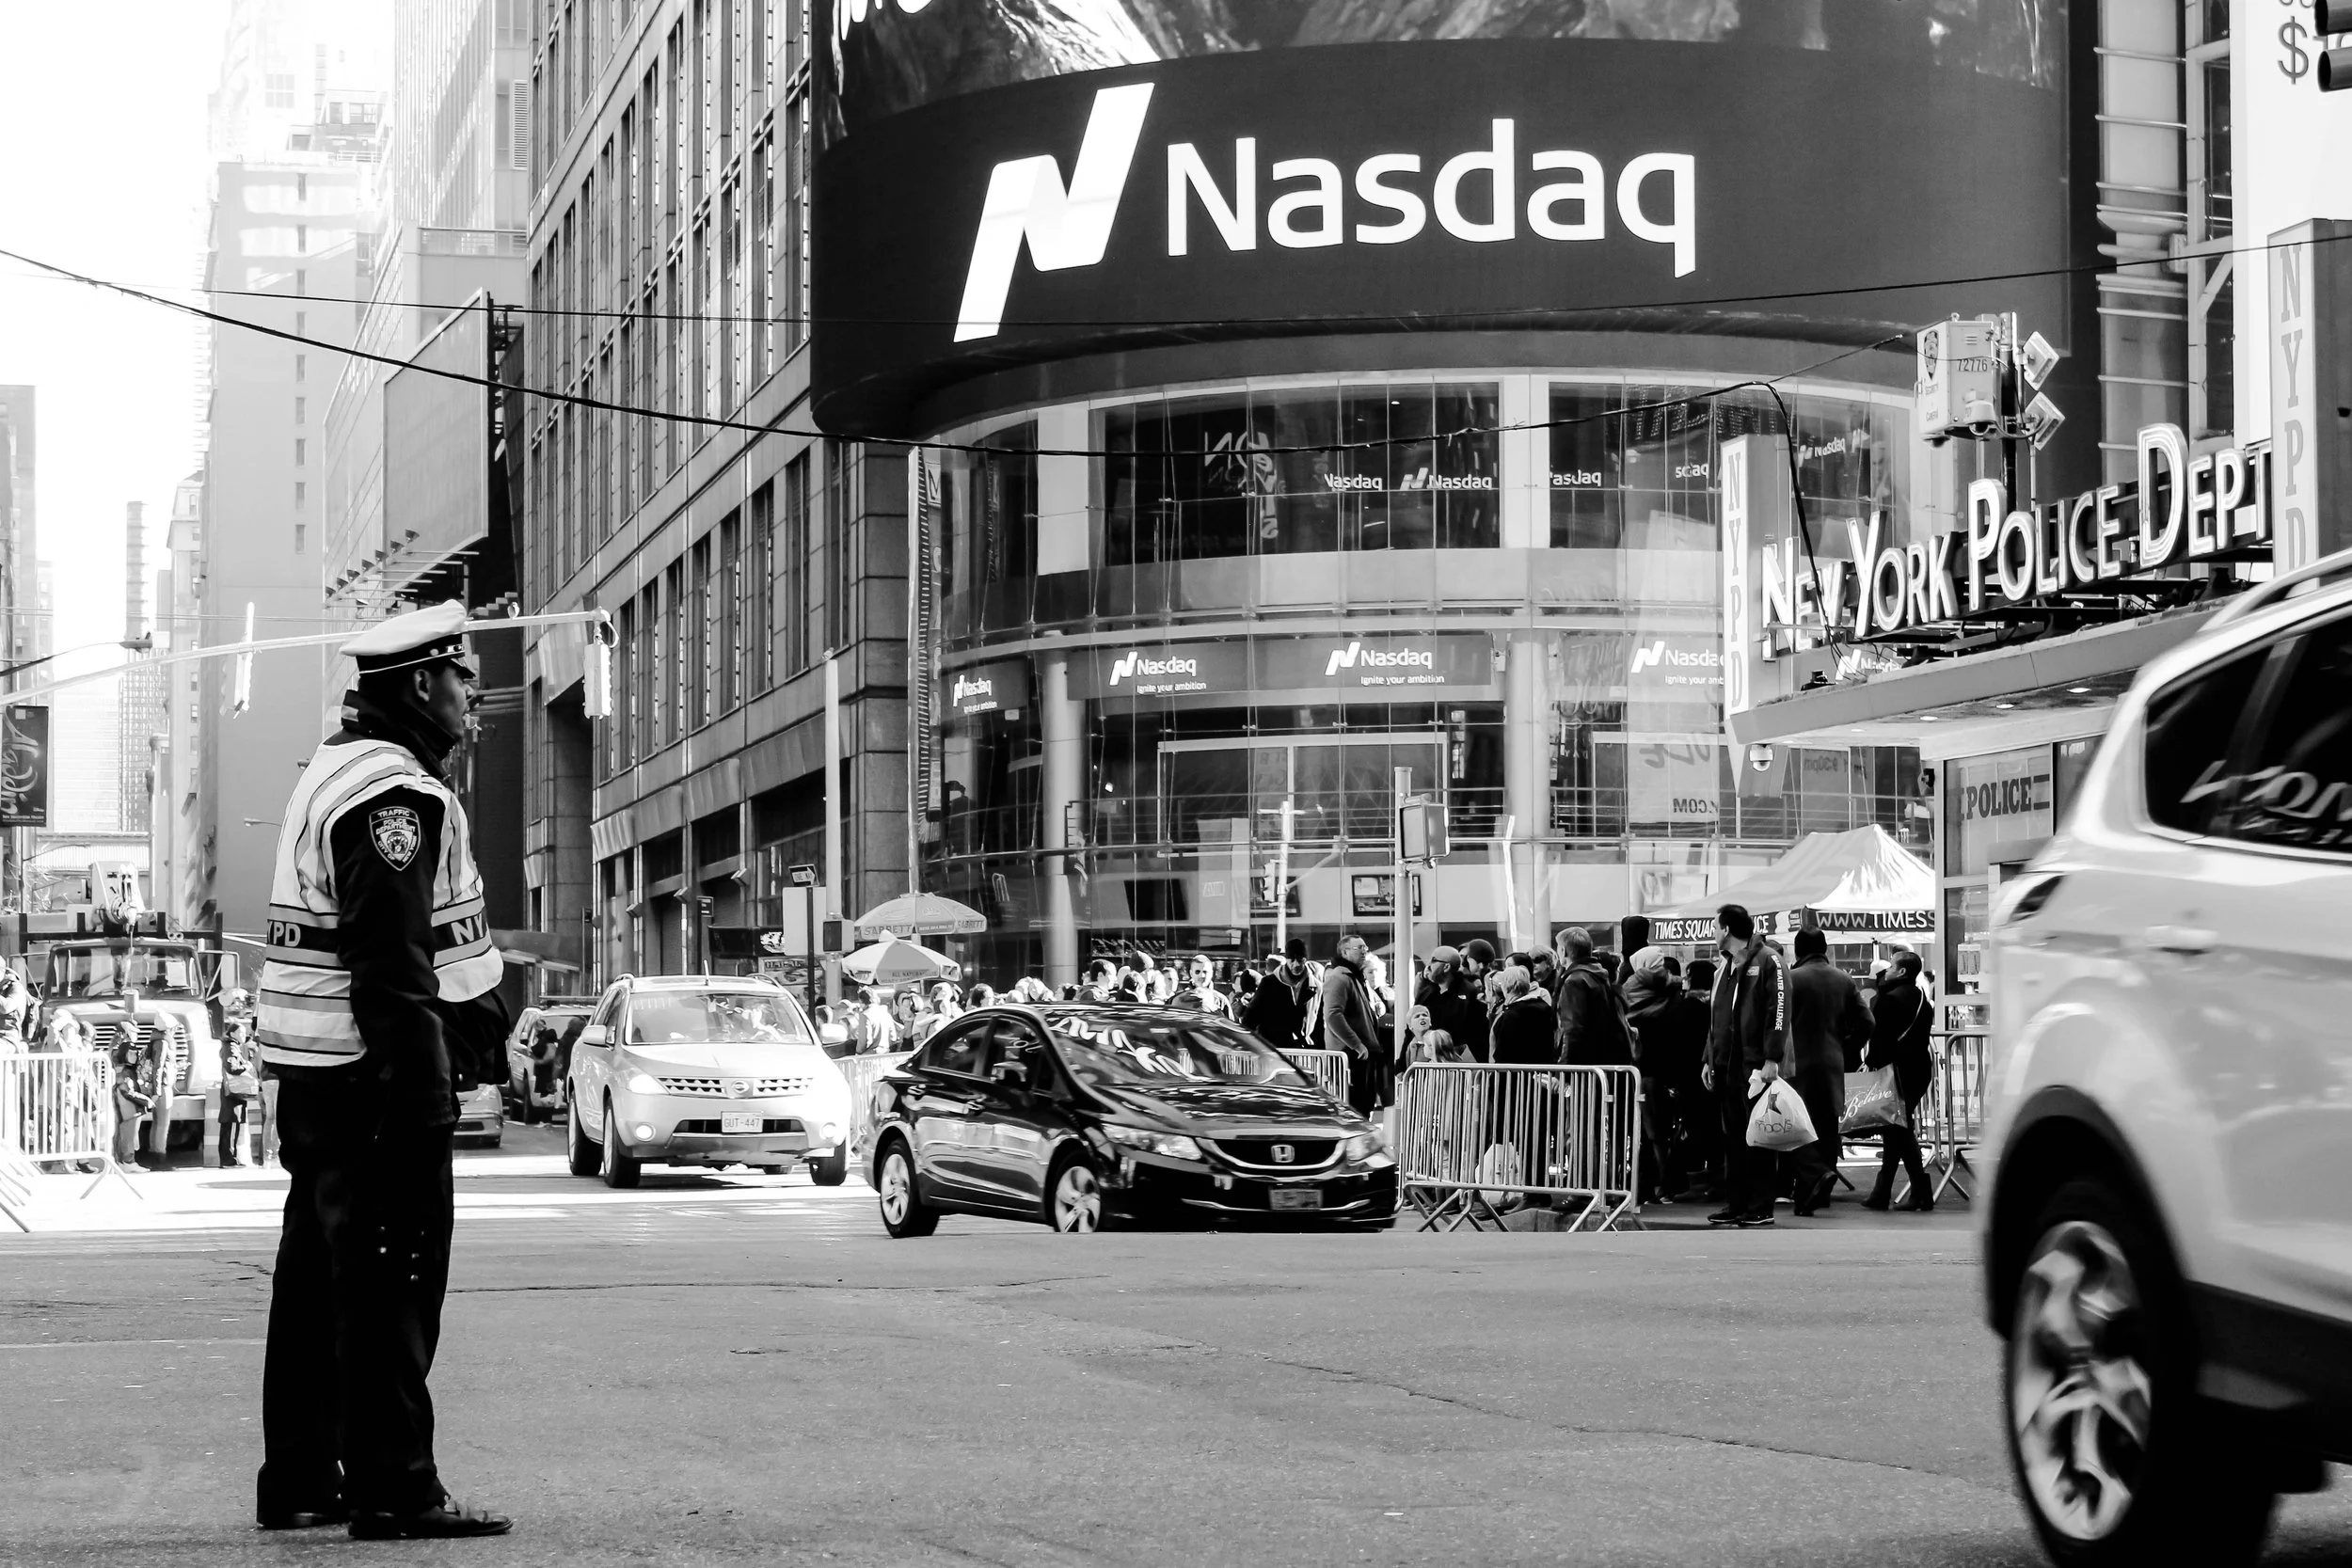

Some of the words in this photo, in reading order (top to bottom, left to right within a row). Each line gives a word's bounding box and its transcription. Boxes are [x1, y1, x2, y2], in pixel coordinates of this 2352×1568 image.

[1167, 118, 1696, 277] Nasdaq
[1958, 358, 1988, 372] 72776
[2280, 242, 2307, 569] NYPD
[1428, 473, 1493, 491] Nasdaq
[1549, 468, 1602, 487] asdaq
[1846, 510, 1960, 639] YORK
[1967, 478, 2122, 611] POLICE
[2137, 422, 2273, 569] DEPT
[1728, 451, 1743, 708] NYPD
[1137, 656, 1197, 676] Nasdaq
[1360, 647, 1433, 670] Nasdaq
[963, 677, 992, 696] Nasdaq
[1136, 684, 1156, 694] Ignite
[1156, 684, 1173, 693] your
[1175, 681, 1206, 691] ambition
[1360, 675, 1385, 686] Ignite
[1386, 676, 1406, 686] your
[1407, 674, 1445, 684] ambition
[1664, 674, 1688, 686] Ignite
[1689, 676, 1707, 686] your
[1965, 776, 2032, 820] POLICE
[377, 809, 410, 817] TRAFFIC
[1654, 921, 1683, 940] TIMES
[1774, 990, 1785, 1031] CHALLENGE
[1838, 1083, 1893, 1124] Believe
